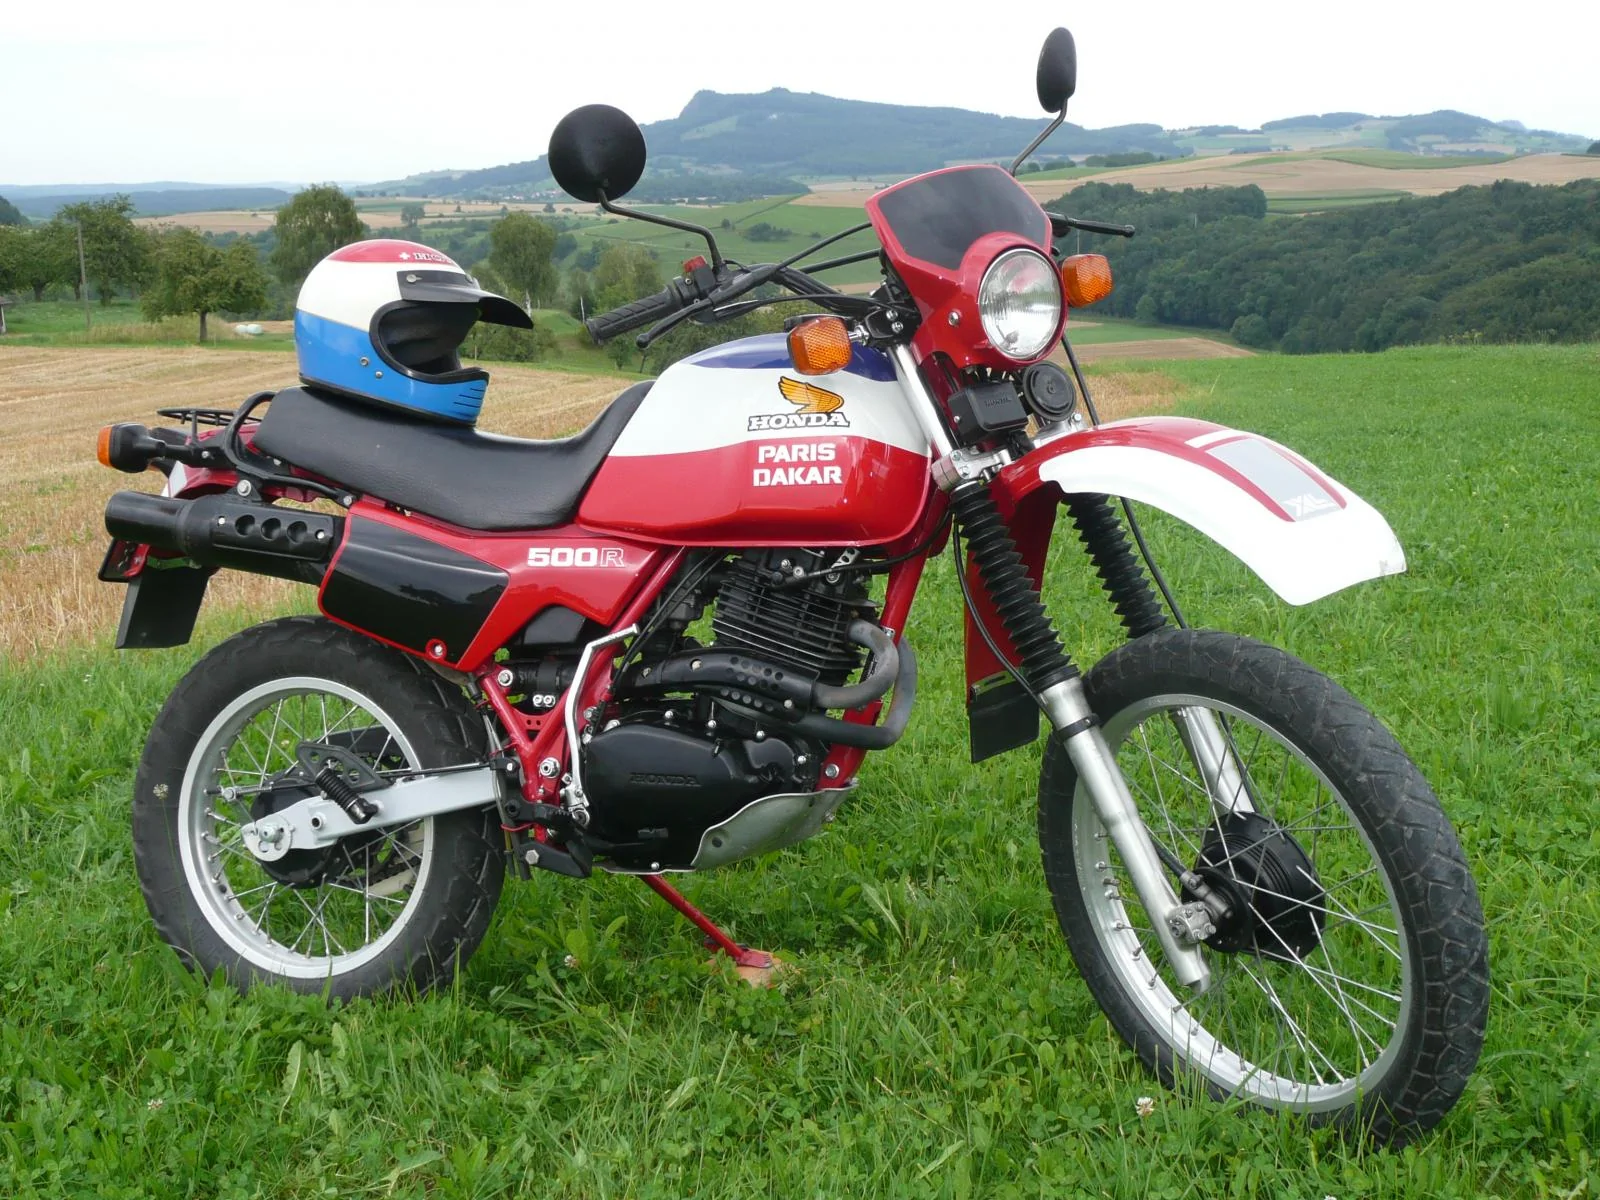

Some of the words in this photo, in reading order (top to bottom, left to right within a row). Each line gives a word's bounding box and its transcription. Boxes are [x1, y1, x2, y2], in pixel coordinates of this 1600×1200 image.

[748, 412, 850, 431] HONDA
[758, 443, 836, 463] PARIS
[753, 466, 842, 486] DAKAR
[527, 547, 625, 567] 500R
[629, 772, 701, 787] HONDA
